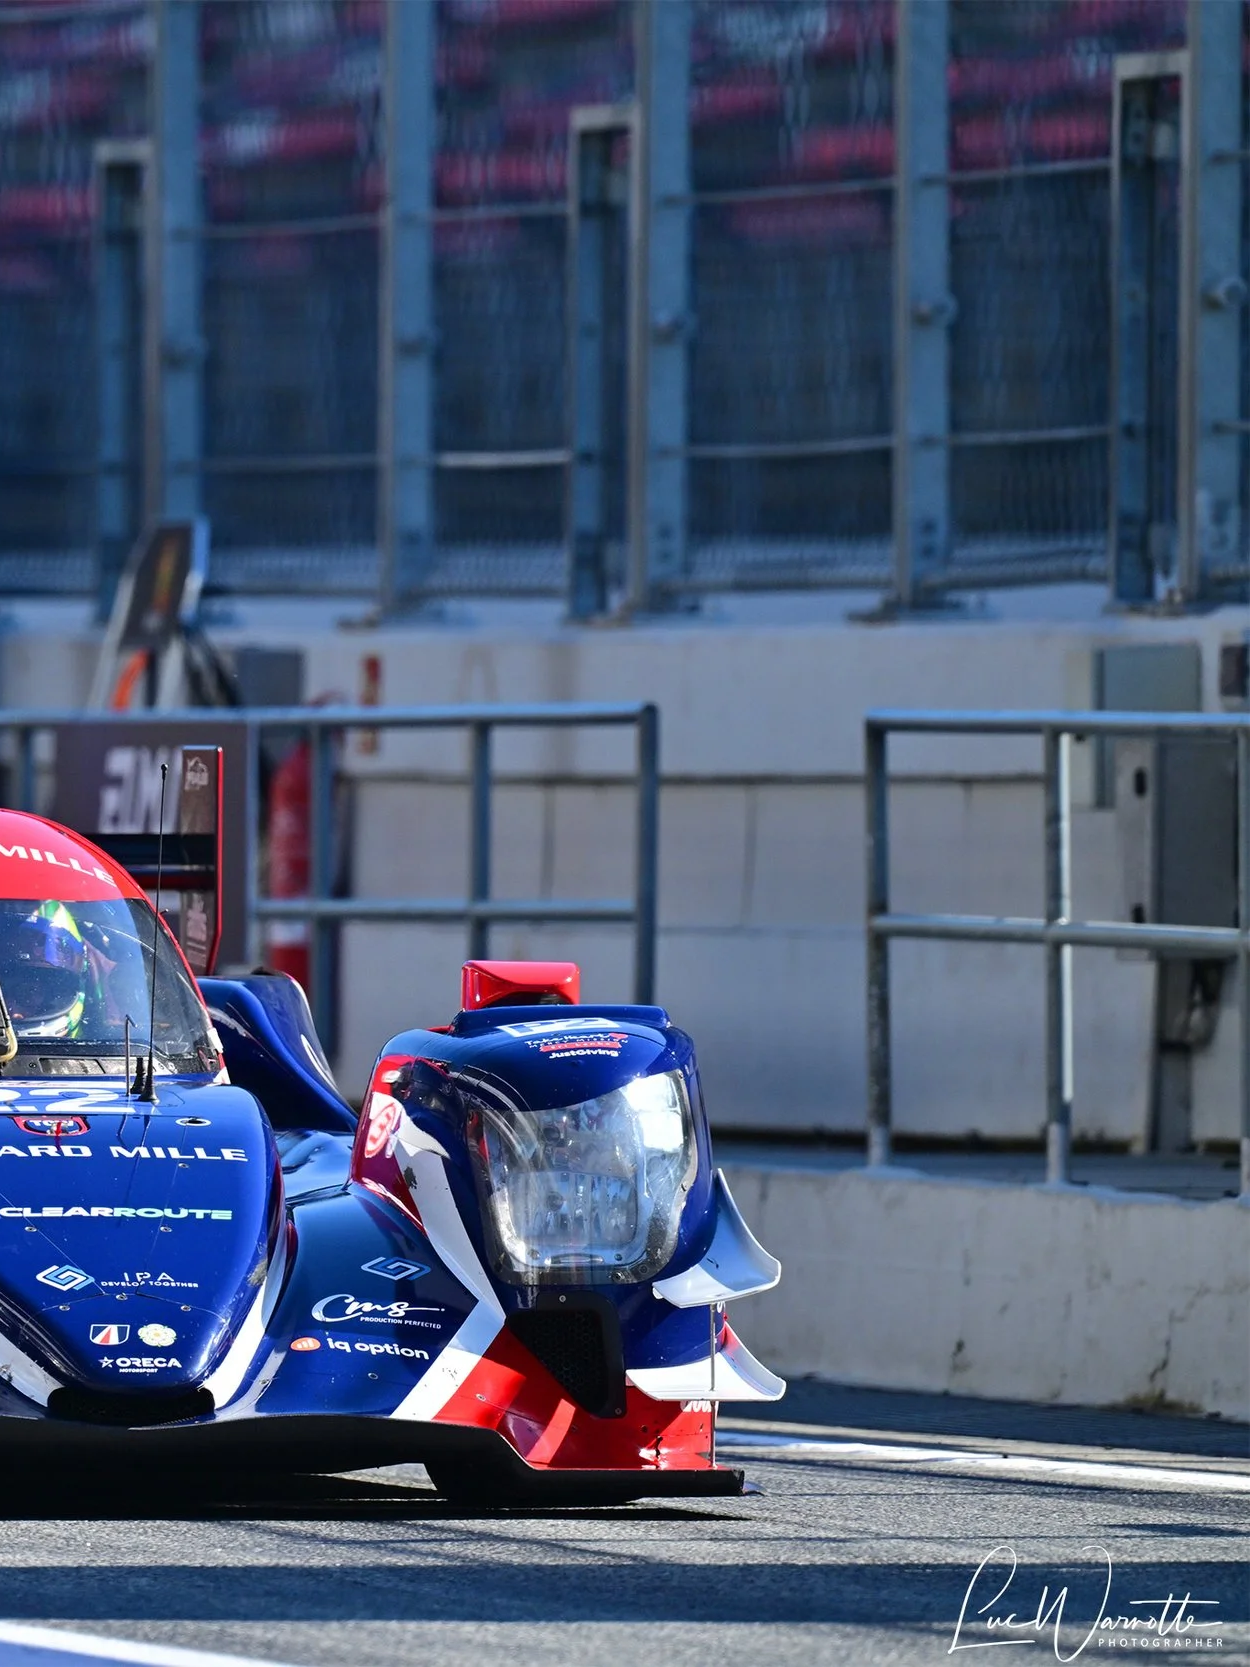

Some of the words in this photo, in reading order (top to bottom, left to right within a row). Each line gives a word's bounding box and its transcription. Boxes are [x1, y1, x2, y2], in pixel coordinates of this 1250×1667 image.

[549, 1048, 619, 1059] JustGiving
[110, 1146, 249, 1162] MILLE
[0, 1206, 233, 1221] CLEARROUTE
[148, 1281, 199, 1289] TOGETHER
[360, 1316, 403, 1325] PRODUCTION
[404, 1319, 442, 1330] PERFECTED
[326, 1337, 352, 1352] iq
[354, 1341, 430, 1360] option
[116, 1357, 182, 1368] ORECA
